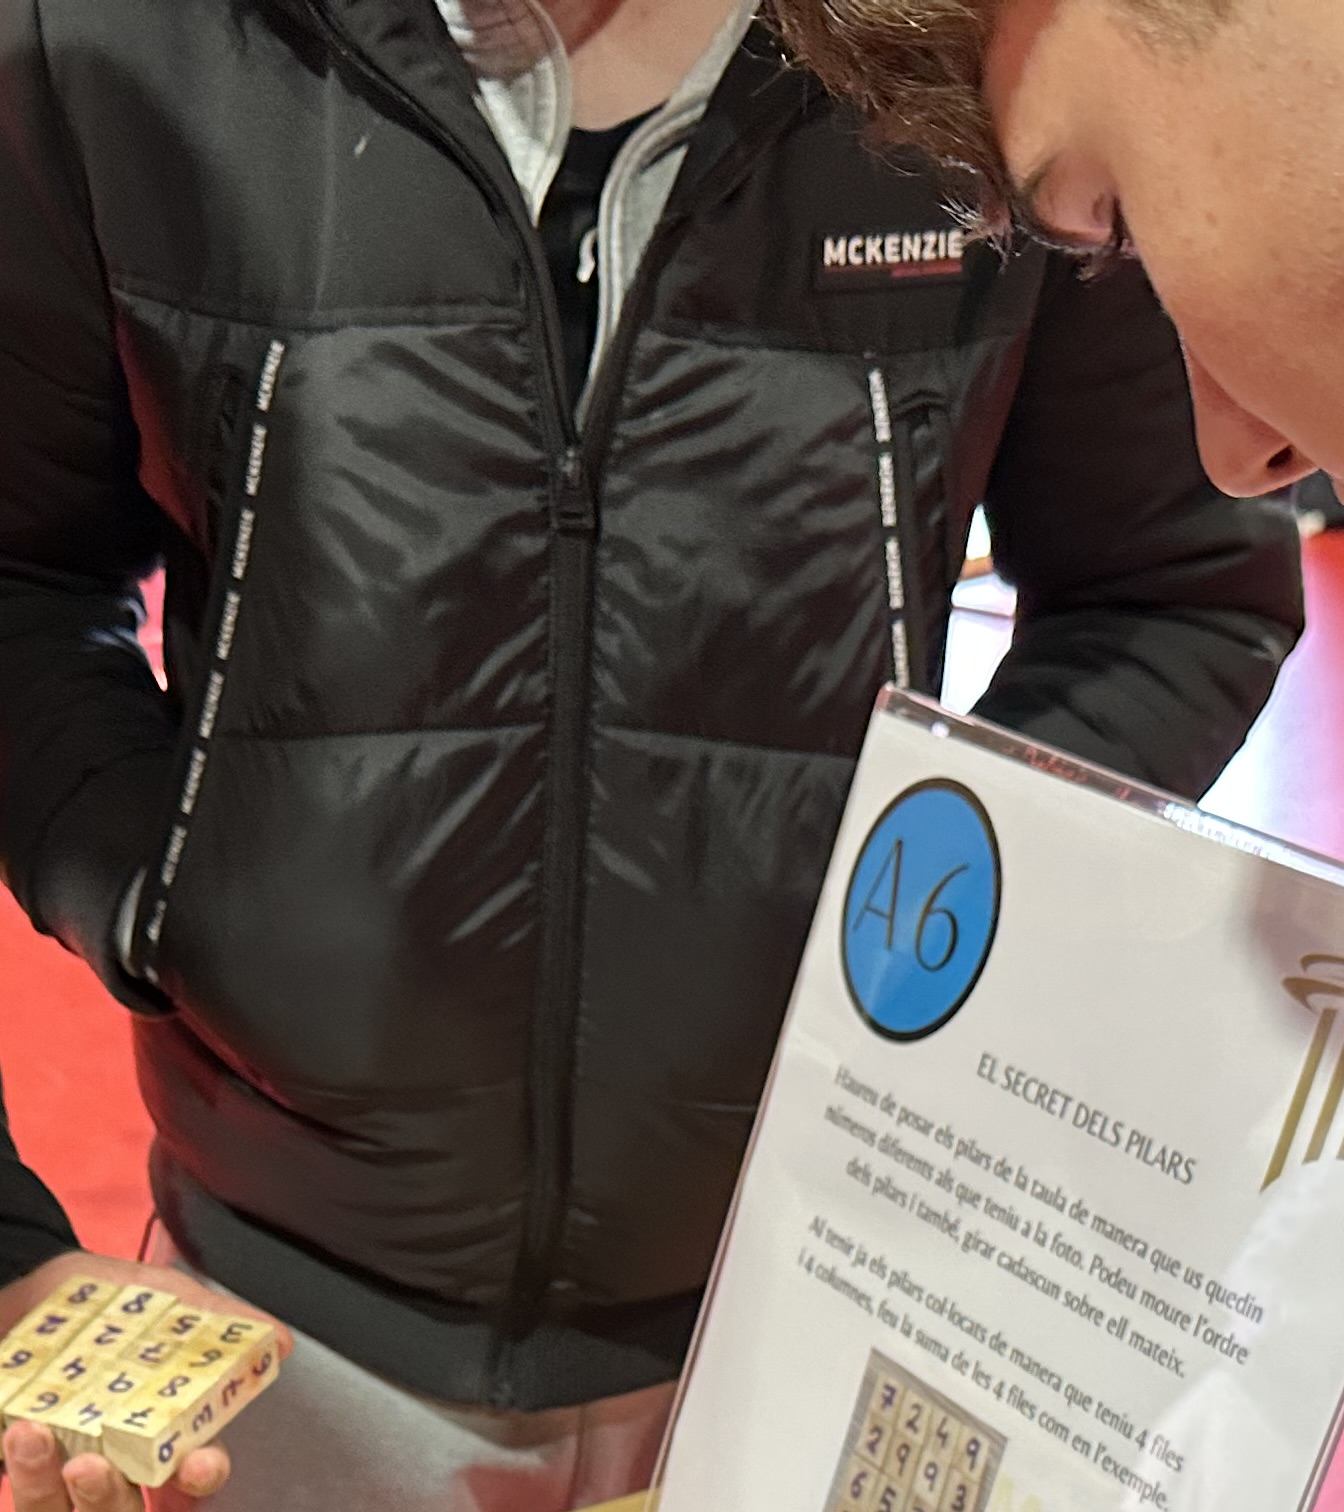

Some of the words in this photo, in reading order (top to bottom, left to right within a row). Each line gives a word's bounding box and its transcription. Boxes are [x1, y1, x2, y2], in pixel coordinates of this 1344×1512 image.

[823, 229, 964, 267] MCKENZIE
[855, 838, 969, 971] A6
[976, 1052, 998, 1084] EL
[999, 1064, 1073, 1120] SECRET
[1071, 1101, 1125, 1148] DELS
[1124, 1128, 1197, 1185] PILARS
[846, 1155, 873, 1185] dels
[871, 1174, 908, 1209] pilars
[907, 1191, 917, 1213] i
[961, 1229, 997, 1261] girar
[995, 1249, 1062, 1300] cadascun
[1061, 1289, 1105, 1327] sobre
[1105, 1315, 1128, 1339] ell
[1127, 1329, 1185, 1379] mateix.
[879, 1091, 897, 1117] de
[896, 1106, 934, 1137] posar
[933, 1123, 955, 1148] els
[953, 1137, 993, 1172] pilars
[992, 1155, 1013, 1183] de
[1013, 1164, 1029, 1191] la
[1029, 1177, 1067, 1213] taula
[1067, 1197, 1090, 1225] de
[1090, 1214, 1149, 1259] manera
[1148, 1247, 1182, 1278] que
[1182, 1266, 1204, 1291] us
[1203, 1278, 1264, 1324] quedin
[934, 1167, 955, 1192] als
[953, 1182, 981, 1210] que
[982, 1195, 1020, 1231] teniu
[1020, 1219, 1032, 1238] a
[1032, 1220, 1048, 1248] la
[1049, 1230, 1083, 1270] foto.
[1087, 1253, 1138, 1300] Podeu
[1139, 1289, 1192, 1332] moure
[868, 1254, 888, 1278] els
[886, 1268, 924, 1303] pilars
[987, 1330, 1008, 1356] de
[1008, 1347, 1063, 1393] manera
[1062, 1382, 1093, 1413] que
[1094, 1400, 1134, 1439] teniu
[1133, 1428, 1148, 1449] 4
[1149, 1433, 1185, 1473] files
[877, 1298, 899, 1329] feu
[899, 1313, 914, 1337] la
[913, 1327, 949, 1362] suma
[950, 1349, 970, 1376] de
[970, 1360, 992, 1390] les
[991, 1379, 1005, 1400] 4
[1005, 1383, 1037, 1421] files
[1036, 1409, 1070, 1442] com
[1070, 1432, 1092, 1457] en
[879, 1382, 896, 1409] 7
[905, 1401, 922, 1434] 2
[934, 1414, 950, 1448] 4
[964, 1435, 981, 1471] 9
[850, 1468, 868, 1500] 6
[864, 1422, 883, 1455] 2
[895, 1440, 911, 1477] 9
[922, 1459, 938, 1492] 9
[949, 1481, 967, 1512] 3
